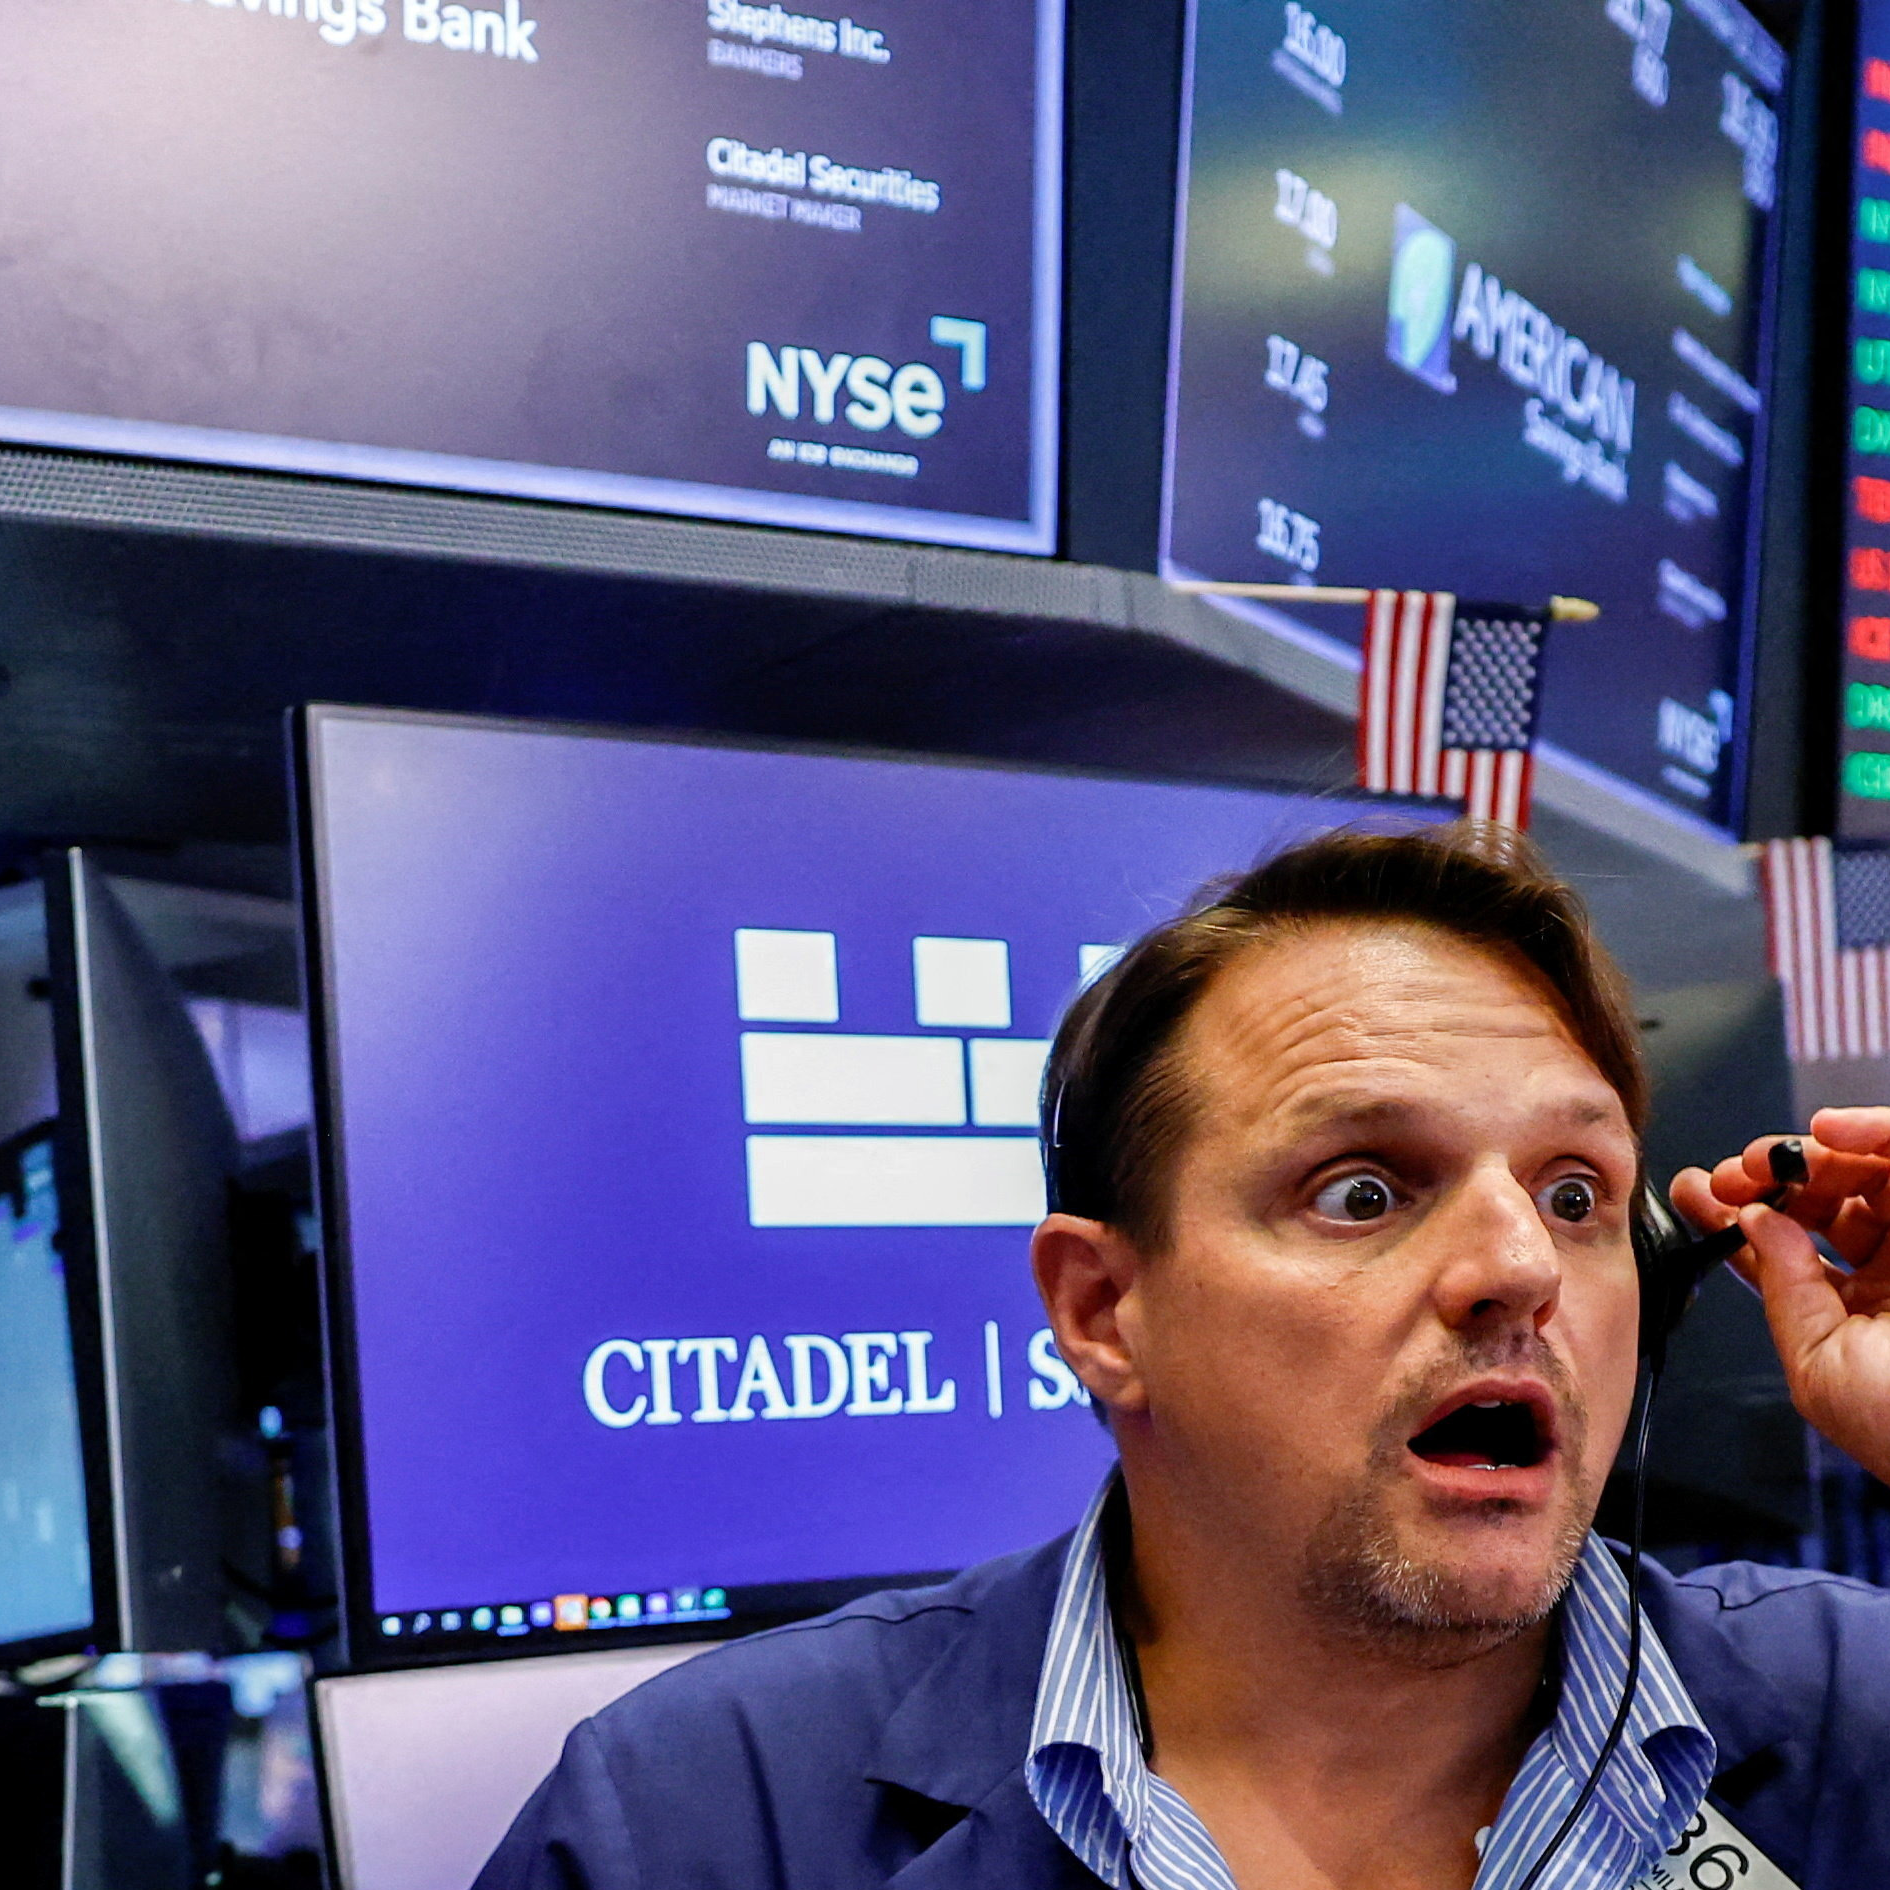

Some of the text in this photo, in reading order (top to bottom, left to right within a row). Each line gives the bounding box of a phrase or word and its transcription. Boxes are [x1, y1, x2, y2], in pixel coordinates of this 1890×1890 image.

[403, 0, 539, 62] Bank
[707, 0, 890, 64] Stephens Inc.
[707, 137, 940, 213] Citadel Securities
[1455, 262, 1635, 456] AMERICAN
[582, 1330, 957, 1428] CITADEL
